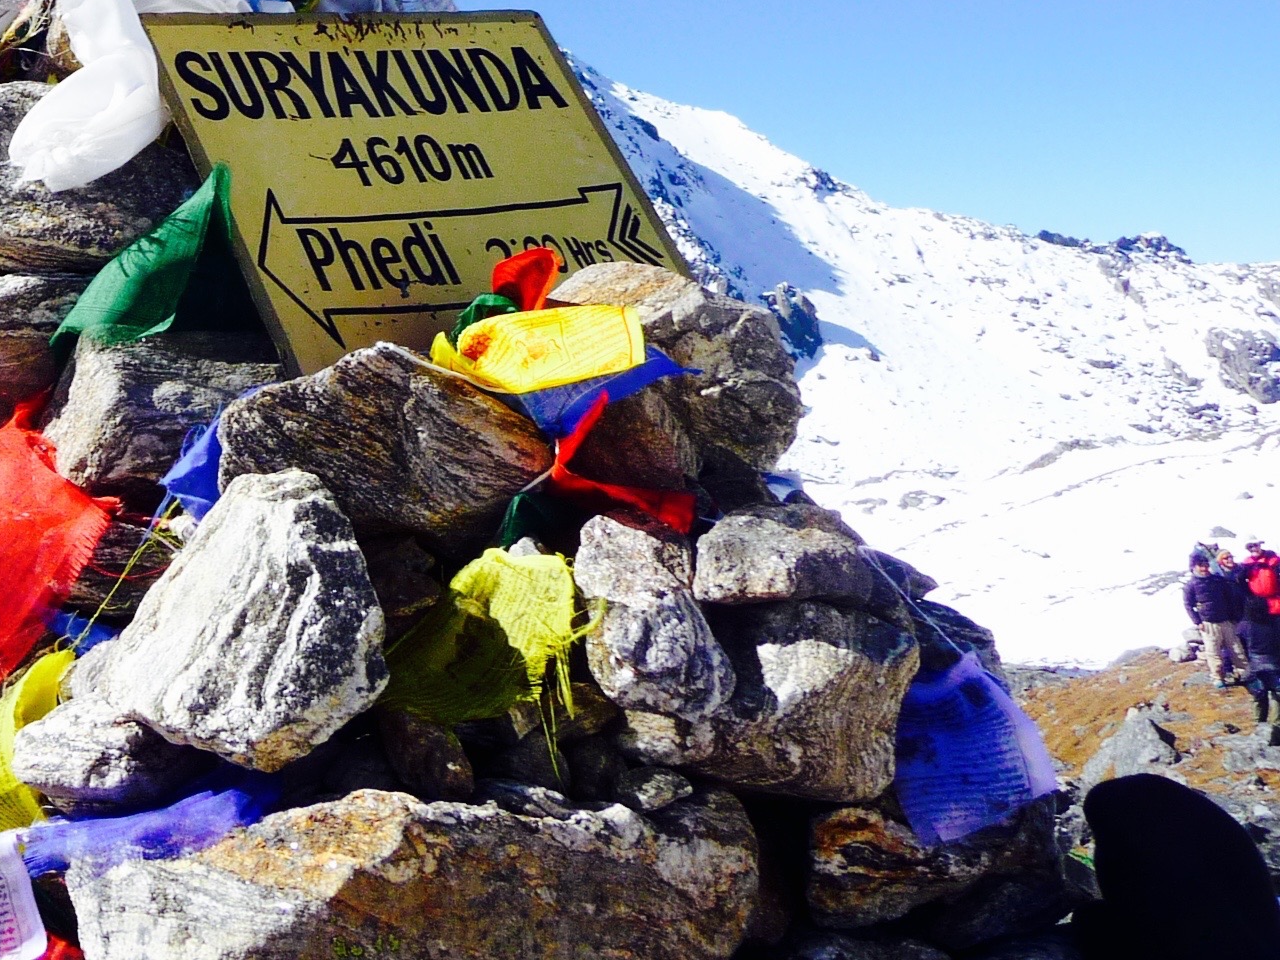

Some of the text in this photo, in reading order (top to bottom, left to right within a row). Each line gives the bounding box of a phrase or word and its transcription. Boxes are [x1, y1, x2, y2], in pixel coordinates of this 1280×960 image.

[175, 47, 569, 120] SURYAKUNDA
[330, 134, 494, 186] 4610m
[295, 221, 461, 291] Phedi
[562, 236, 615, 269] Hrs
